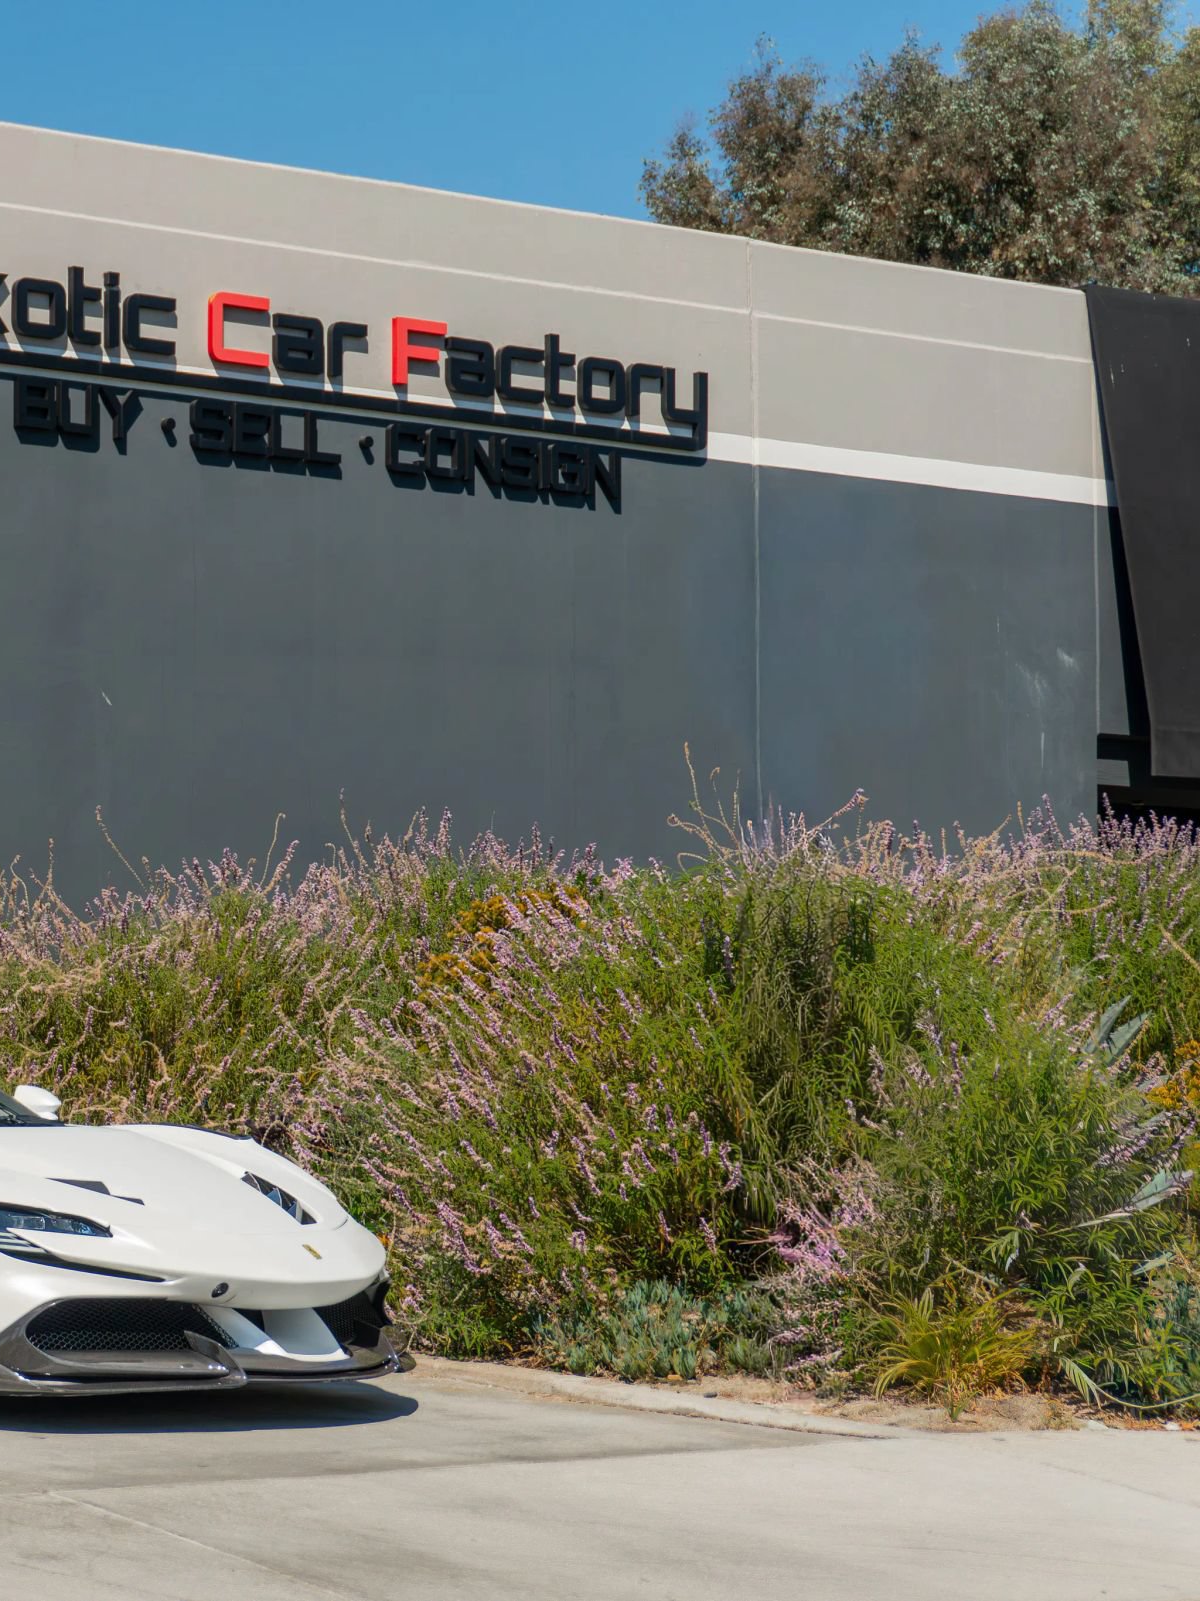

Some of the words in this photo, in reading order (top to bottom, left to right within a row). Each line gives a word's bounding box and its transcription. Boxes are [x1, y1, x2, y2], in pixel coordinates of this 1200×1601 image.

[14, 377, 140, 440] BUY
[190, 399, 341, 464] SELL
[385, 423, 621, 506] CONSIGN
[208, 292, 368, 377] Car
[392, 316, 708, 451] Factory
